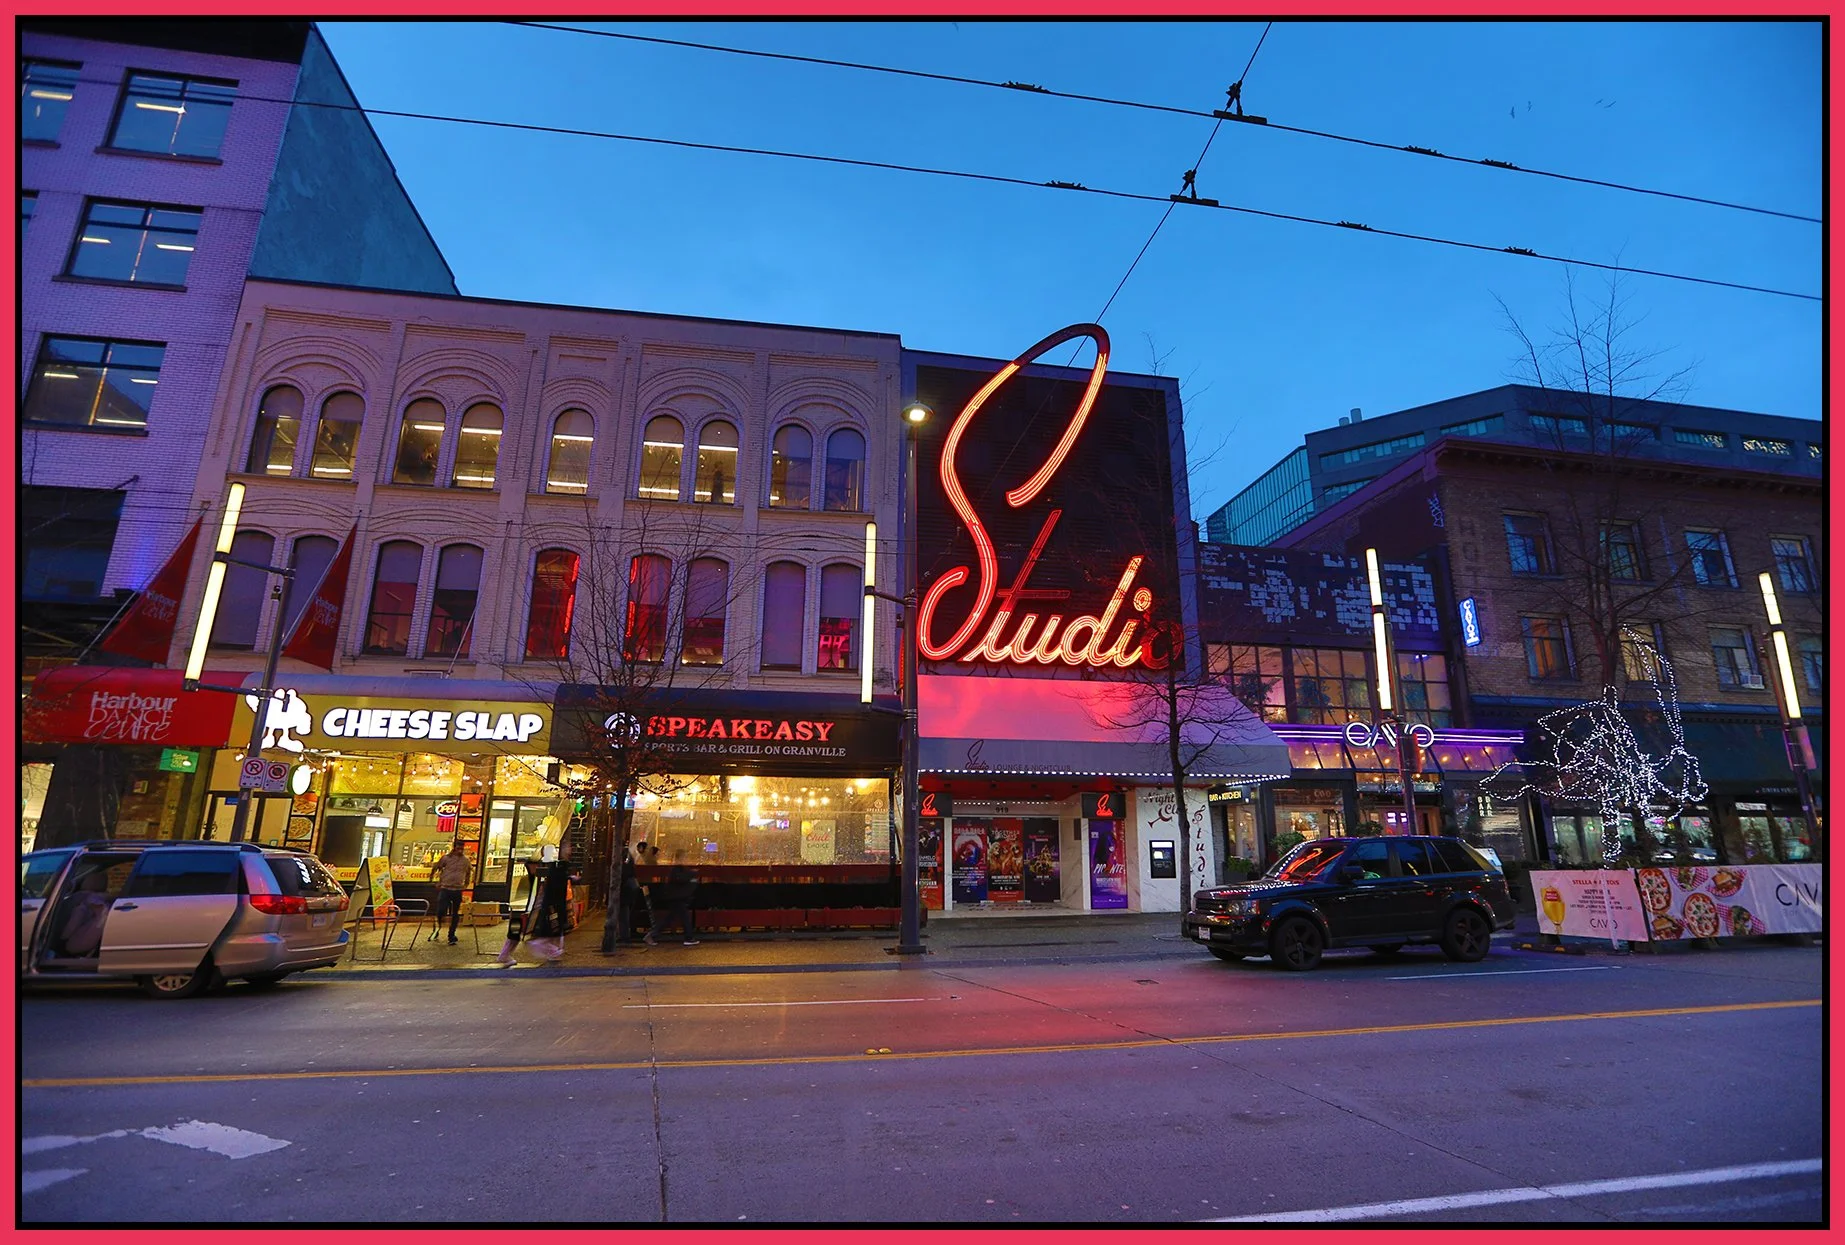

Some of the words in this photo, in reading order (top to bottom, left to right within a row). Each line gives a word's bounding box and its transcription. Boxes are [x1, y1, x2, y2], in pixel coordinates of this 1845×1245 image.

[916, 322, 1183, 669] Studio
[91, 691, 177, 711] Harbour
[89, 707, 173, 724] DANCE
[322, 708, 451, 740] CHEESE
[454, 711, 543, 742] SLAP
[648, 715, 835, 741] SPEAKEASY
[1345, 721, 1435, 749] CAVO
[729, 745, 763, 754] GRILL
[765, 746, 781, 755] ON
[783, 746, 847, 757] GRANVILLE
[993, 763, 1022, 771] LOUNGE
[1144, 792, 1175, 805] Night
[439, 804, 458, 814] OPEN
